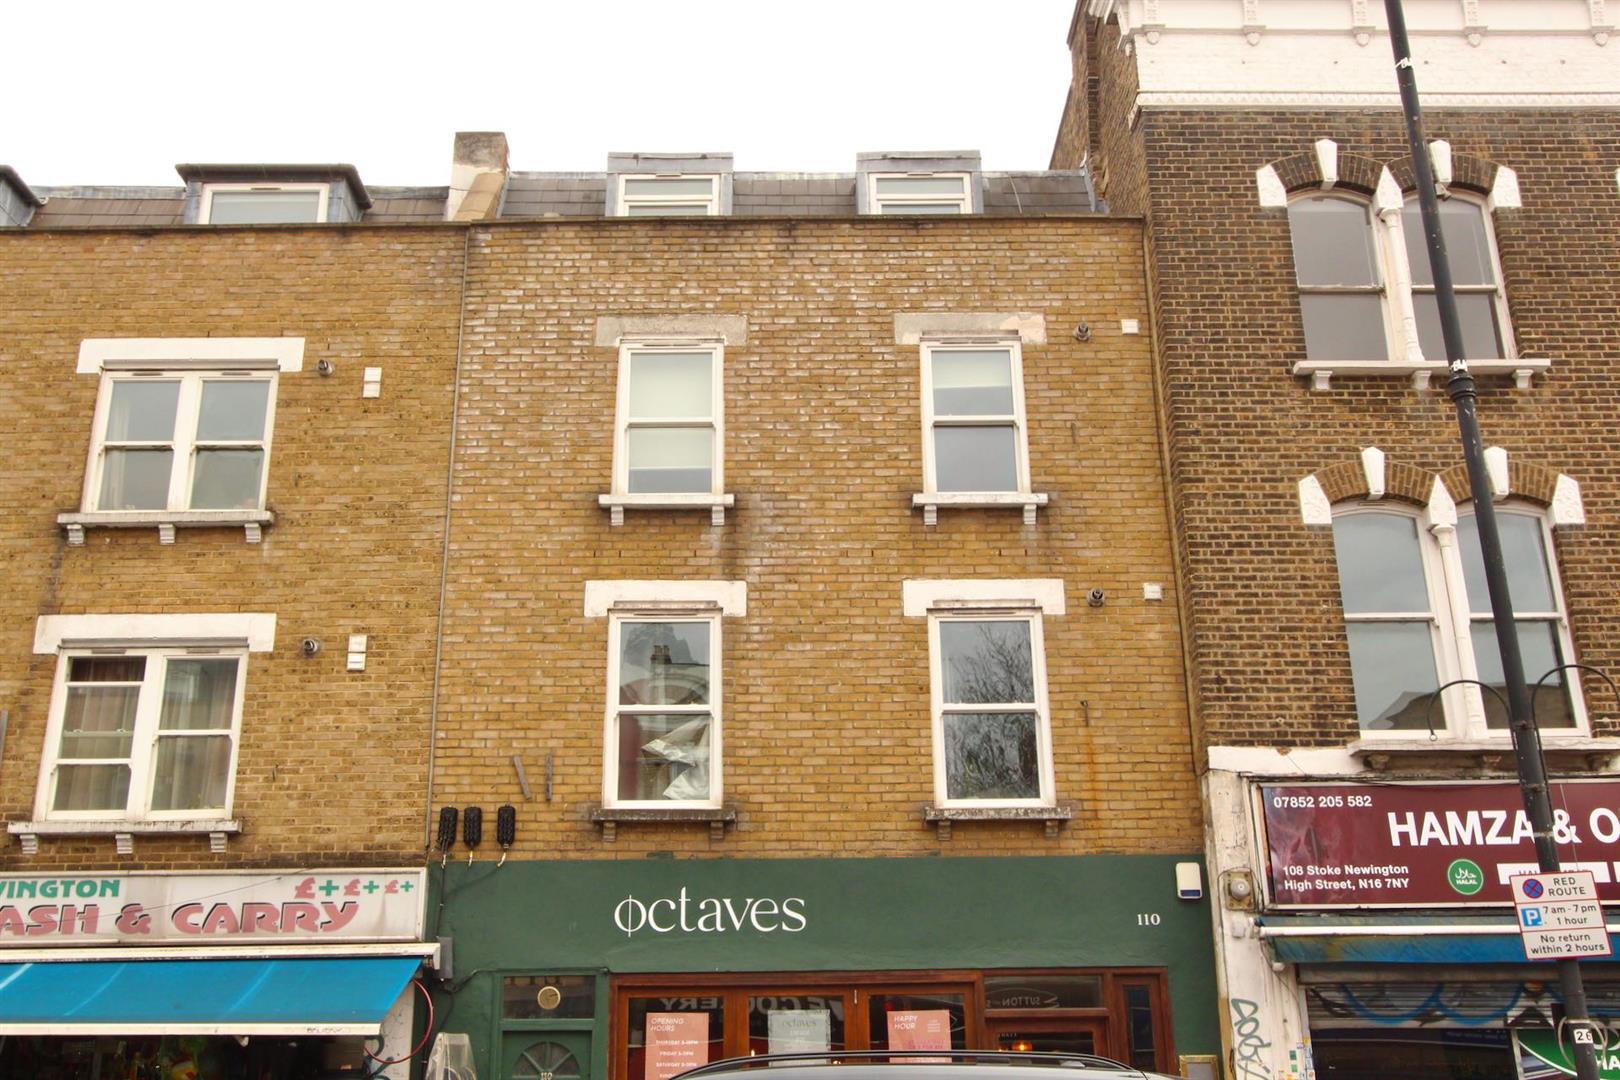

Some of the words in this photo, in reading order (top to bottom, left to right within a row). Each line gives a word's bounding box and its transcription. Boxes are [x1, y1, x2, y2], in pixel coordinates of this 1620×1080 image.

[1273, 796, 1315, 808] 07852
[1319, 796, 1344, 807] 205
[1347, 795, 1373, 807] 582
[1387, 810, 1535, 847] HAMZA
[1552, 809, 1582, 844] &
[1283, 865, 1304, 876] 108
[1306, 865, 1341, 876] Stoke
[1344, 864, 1409, 877] Newington
[1284, 879, 1312, 892] High
[1315, 879, 1356, 891] Street,
[1359, 878, 1382, 889] N16
[1385, 878, 1409, 888] 7NY
[1553, 877, 1576, 886] RED
[1548, 887, 1586, 896] ROUTE
[115, 904, 151, 934] &
[171, 902, 359, 934] CARRY
[1137, 913, 1161, 925] 110
[1564, 917, 1588, 925] hour
[1540, 935, 1555, 943] No
[1558, 934, 1591, 942] return
[1531, 945, 1563, 954] within
[1565, 944, 1572, 952] 2
[1575, 943, 1605, 952] hours
